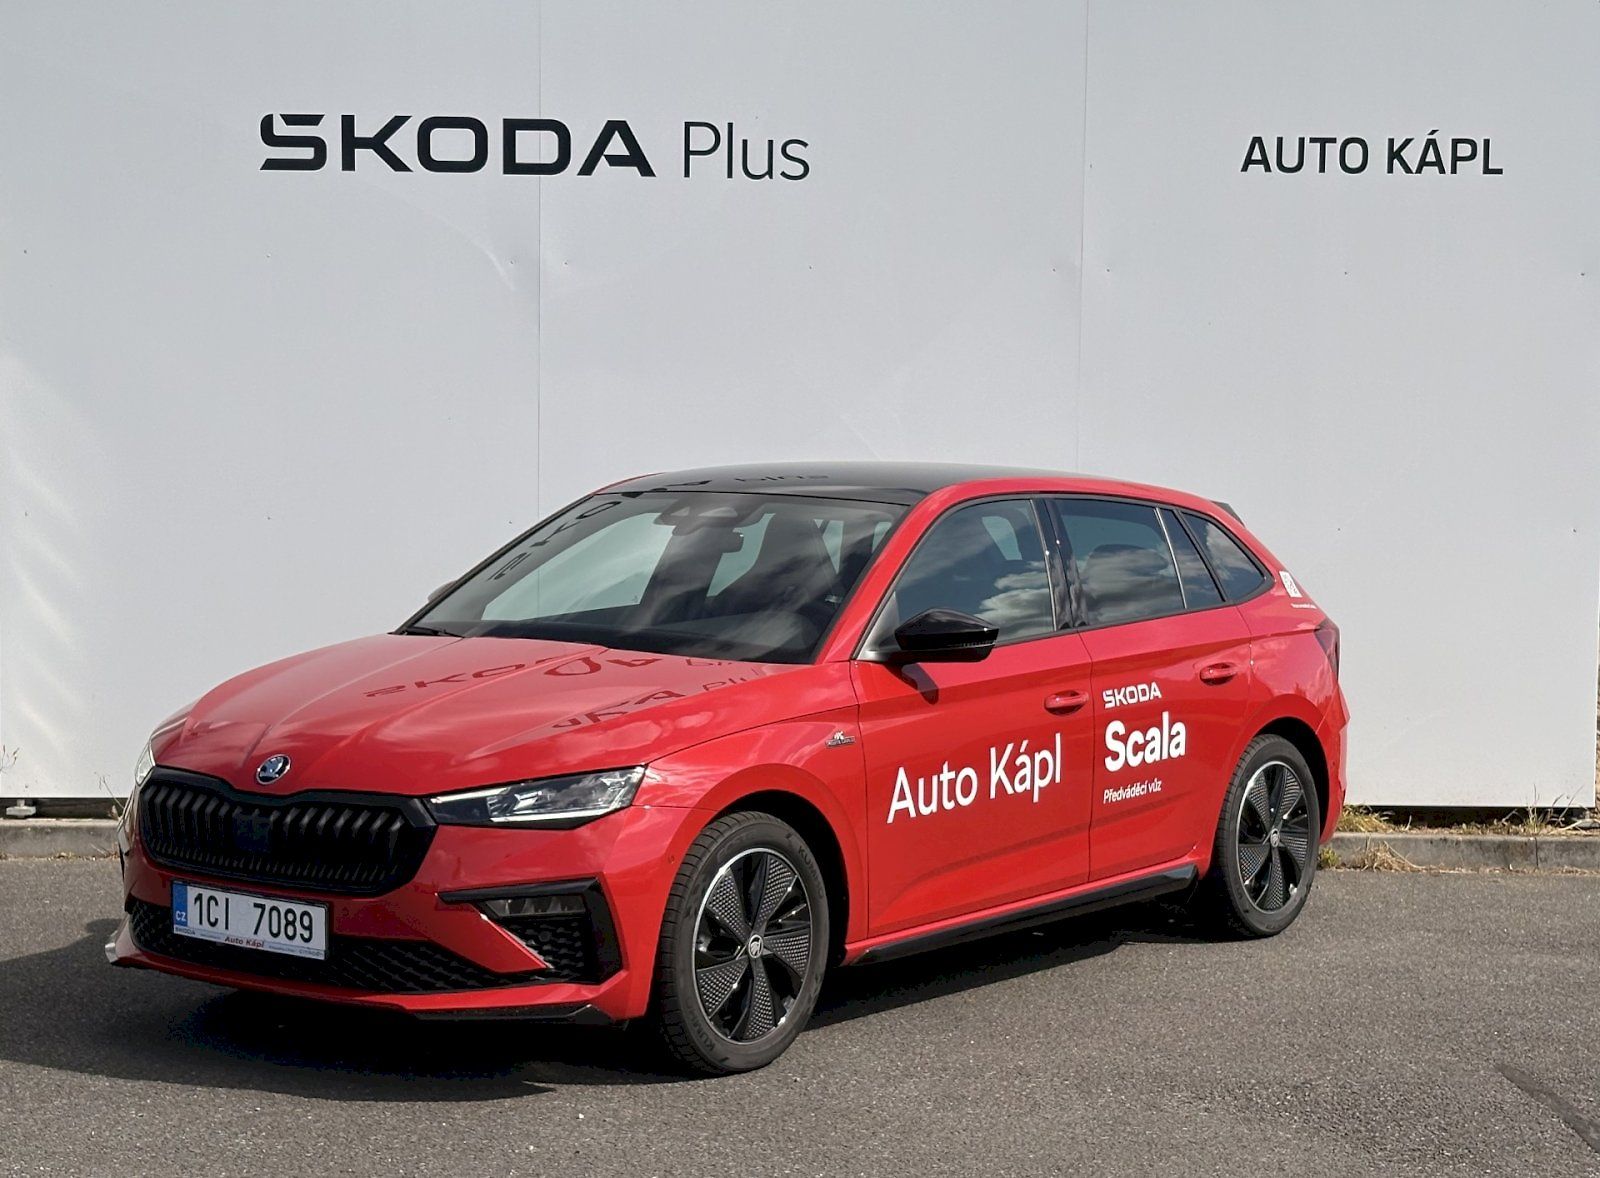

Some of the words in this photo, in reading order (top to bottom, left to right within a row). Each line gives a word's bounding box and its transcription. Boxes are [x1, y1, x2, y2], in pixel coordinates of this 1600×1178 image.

[683, 121, 811, 181] Plus
[1240, 136, 1369, 174] AUTO
[1386, 129, 1503, 175] KÁPL
[1104, 711, 1187, 772] Scala
[886, 760, 979, 824] Auto
[989, 732, 1061, 804] Kápl
[1103, 780, 1148, 804] Předváděcí
[1148, 778, 1162, 794] vůz
[175, 910, 187, 922] CZ
[194, 893, 230, 930] 1CI
[253, 902, 313, 943] 7089
[225, 936, 244, 945] Auto
[246, 939, 265, 949] Kápl
